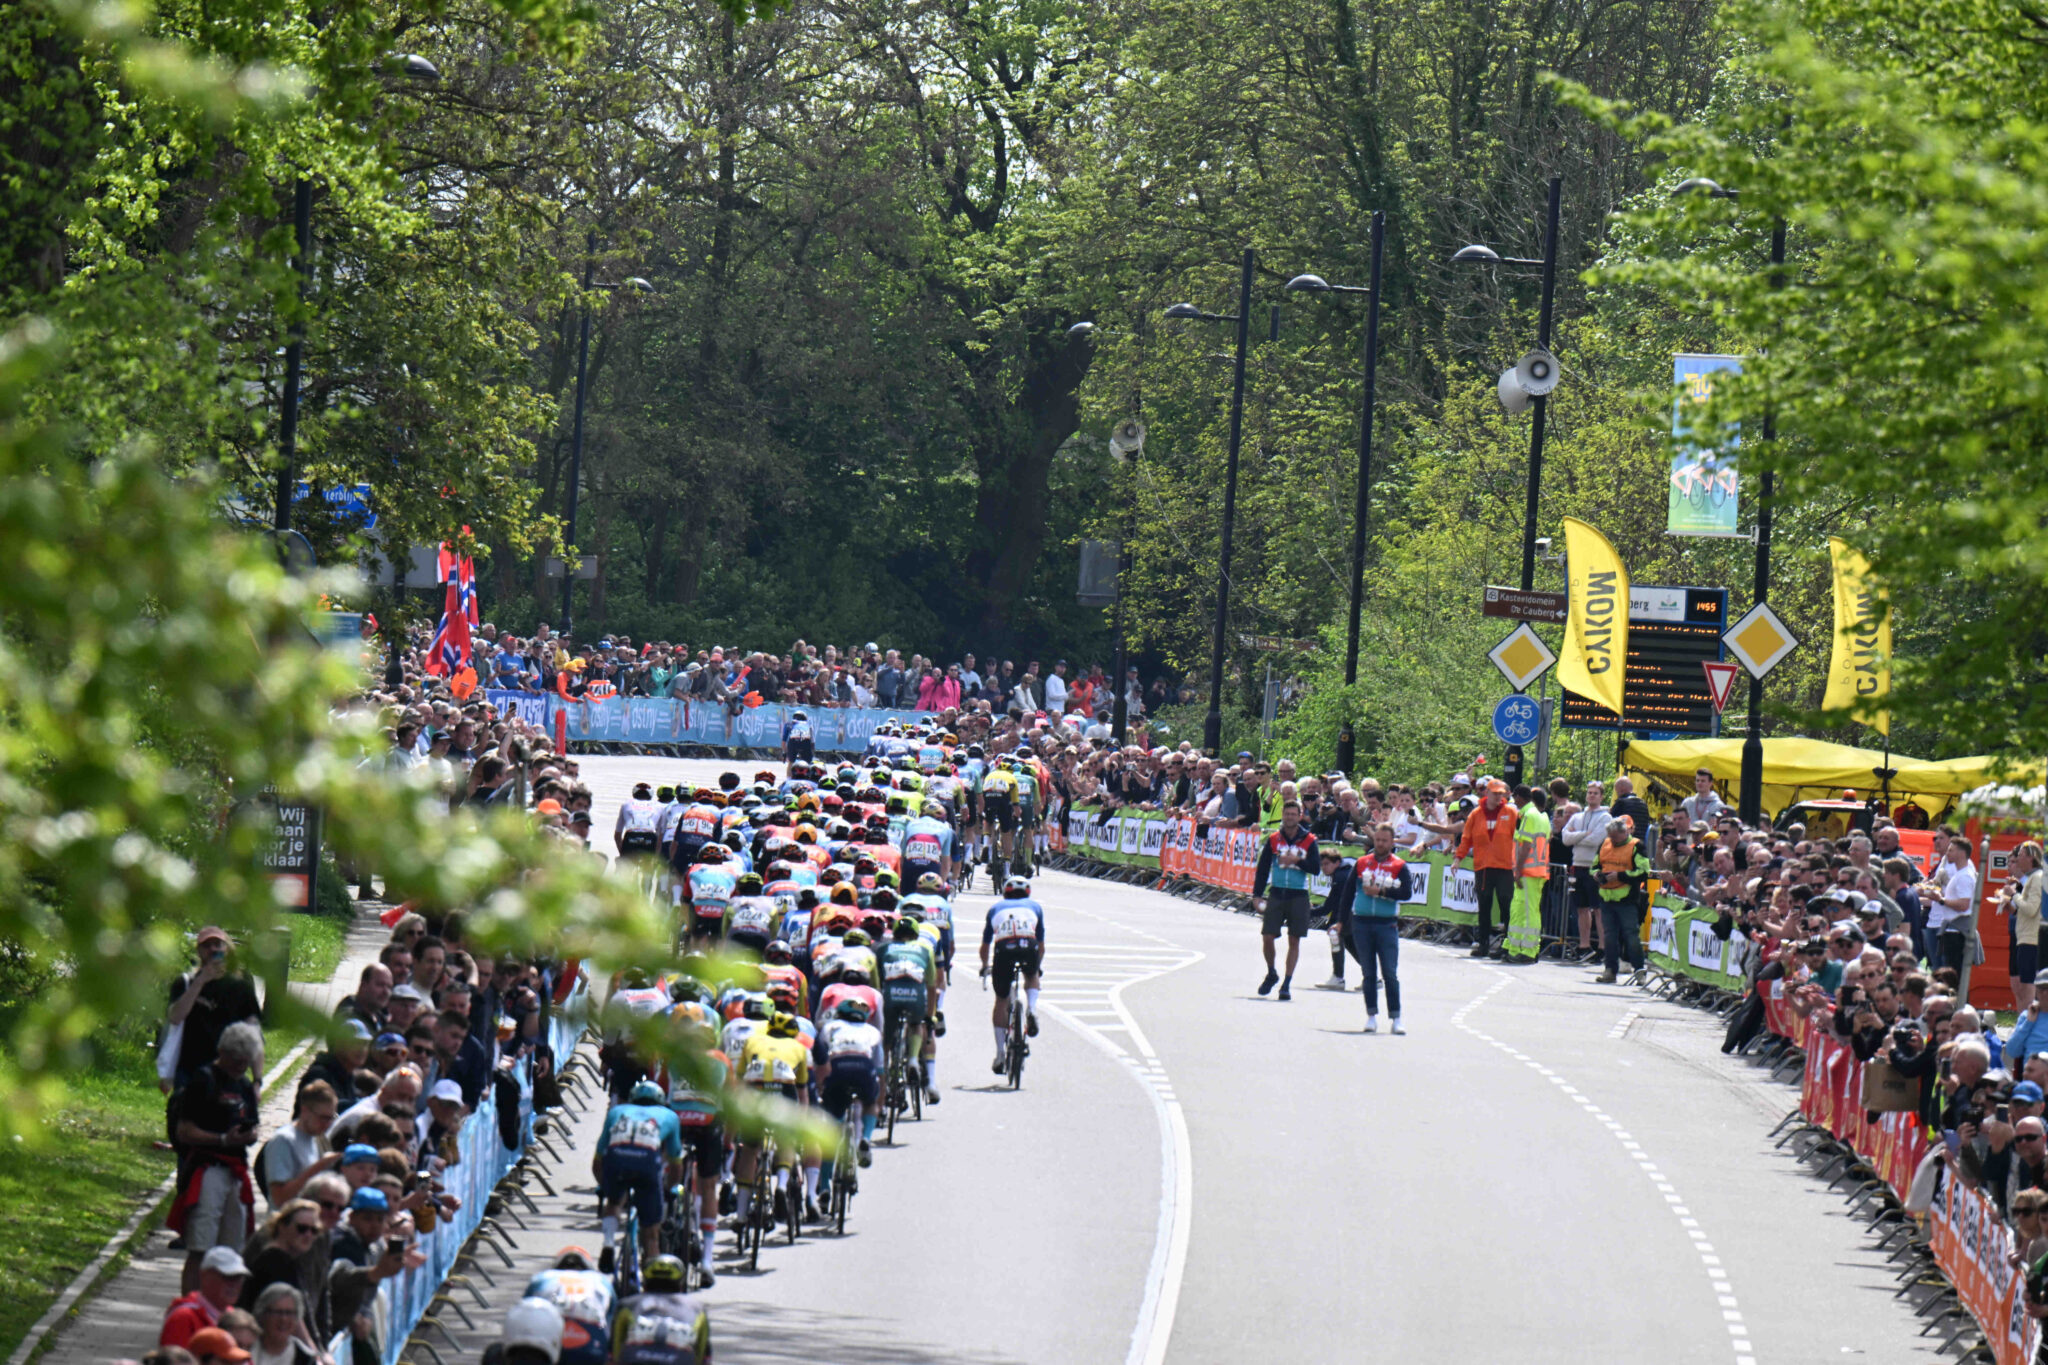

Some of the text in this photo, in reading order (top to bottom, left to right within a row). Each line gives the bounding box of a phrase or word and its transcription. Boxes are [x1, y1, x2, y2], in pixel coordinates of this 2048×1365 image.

[1499, 592, 1556, 607] Kasteeldomein
[1510, 604, 1556, 620] De Cauberg
[279, 807, 305, 826] Wij
[287, 838, 305, 856] je
[263, 852, 305, 868] klaar
